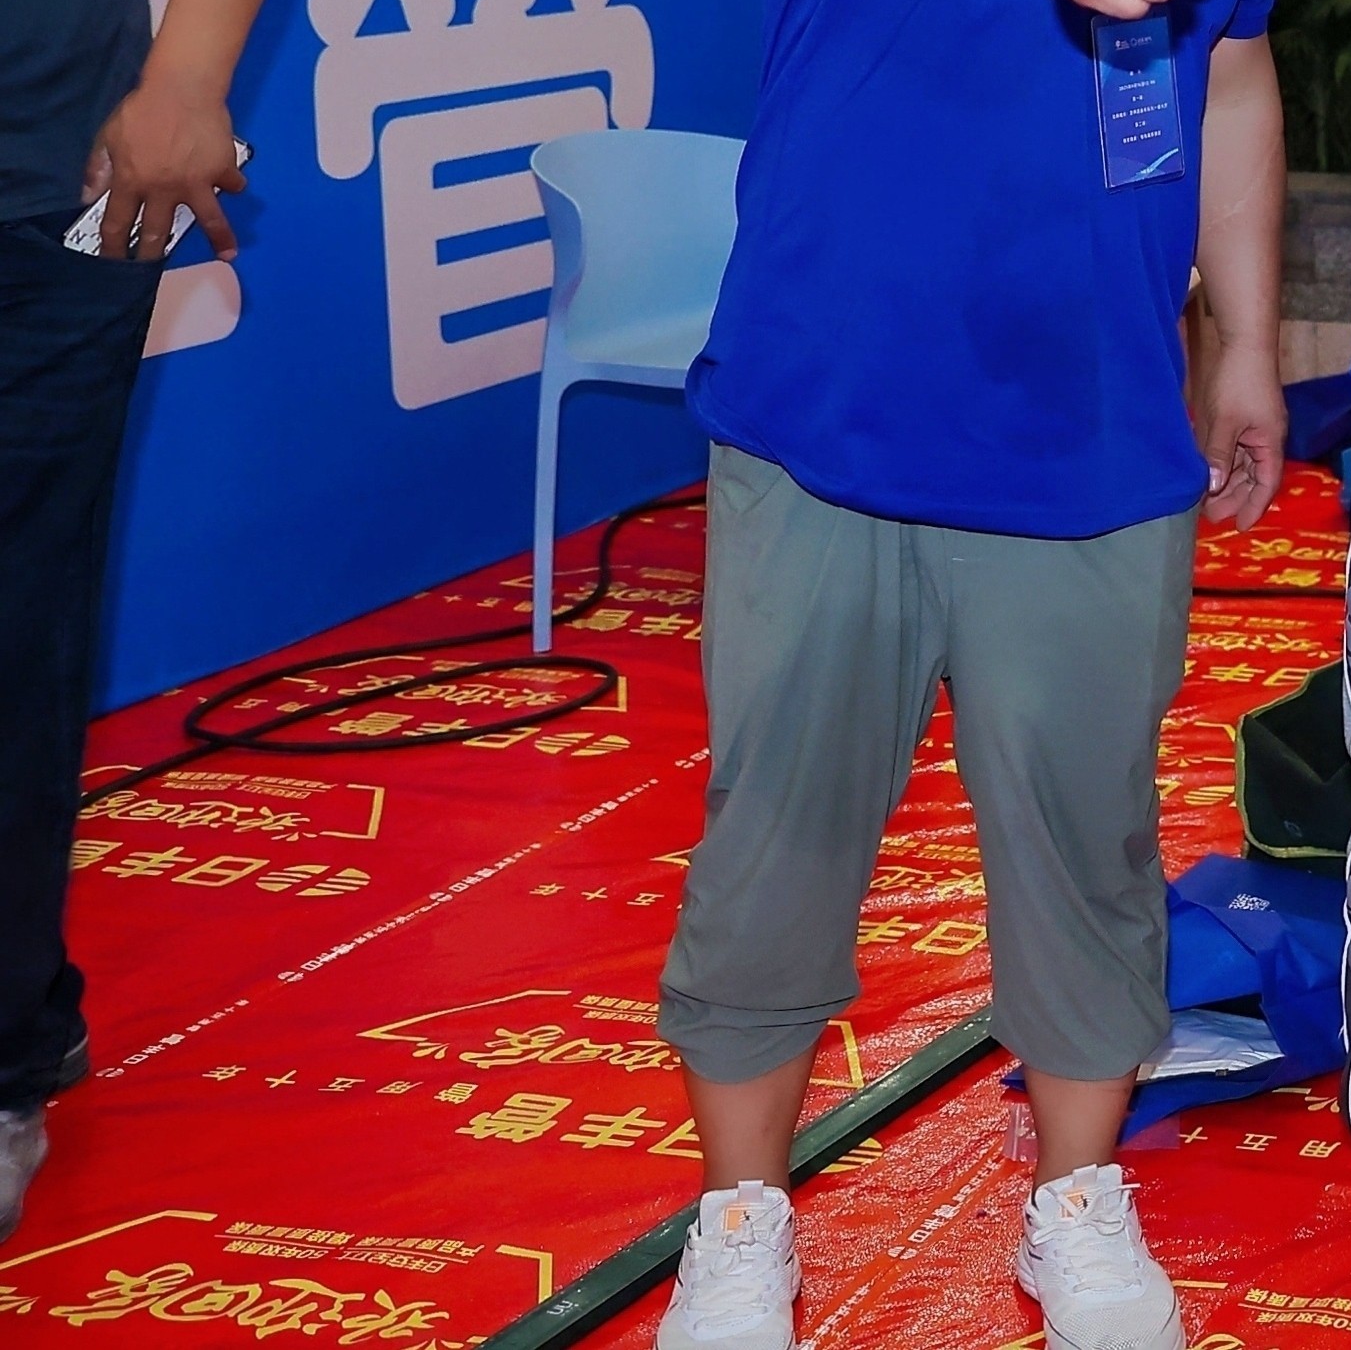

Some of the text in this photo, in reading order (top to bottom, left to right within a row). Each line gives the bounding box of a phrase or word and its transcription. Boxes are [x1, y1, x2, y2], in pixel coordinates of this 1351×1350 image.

[203, 1062, 479, 1105] 管用五十年
